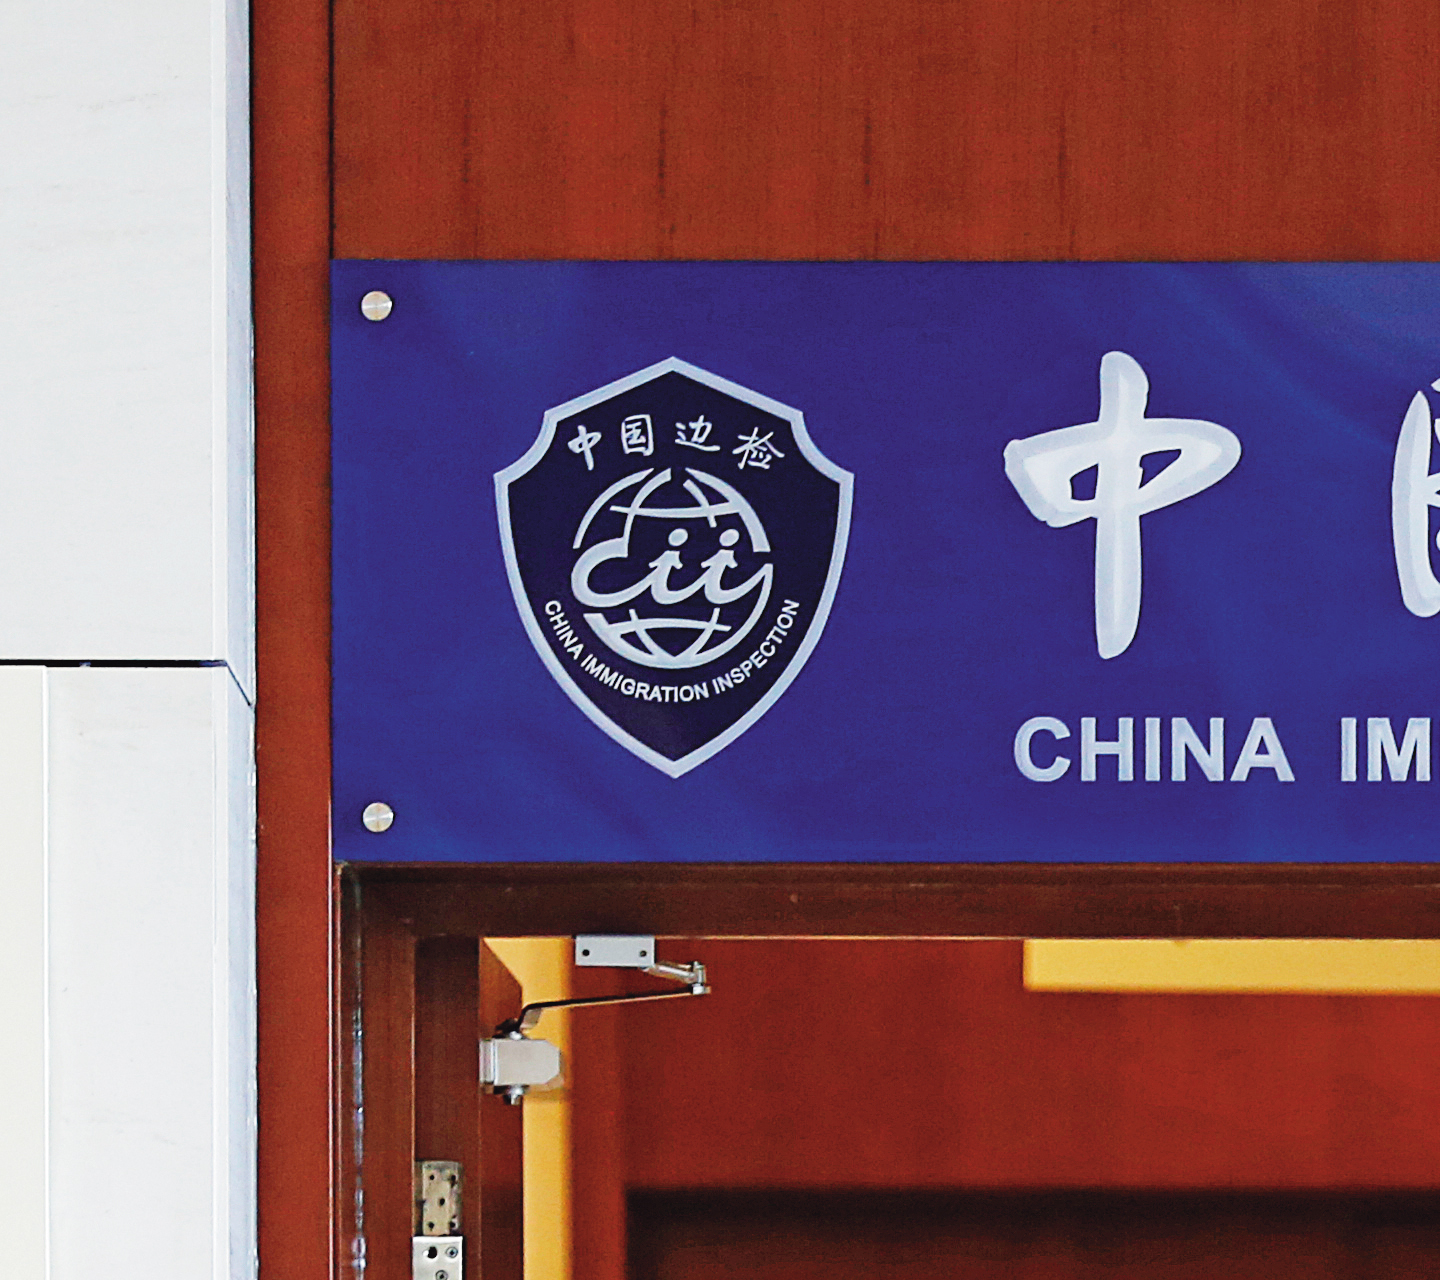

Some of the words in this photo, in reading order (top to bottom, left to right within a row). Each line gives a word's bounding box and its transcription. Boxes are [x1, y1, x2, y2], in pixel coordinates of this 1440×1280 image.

[568, 414, 785, 471] 中国边检
[544, 599, 582, 661] CHINA
[582, 655, 710, 702] IMMIGRATION
[713, 600, 800, 697] INSPECTION
[1014, 717, 1295, 782] CHINA
